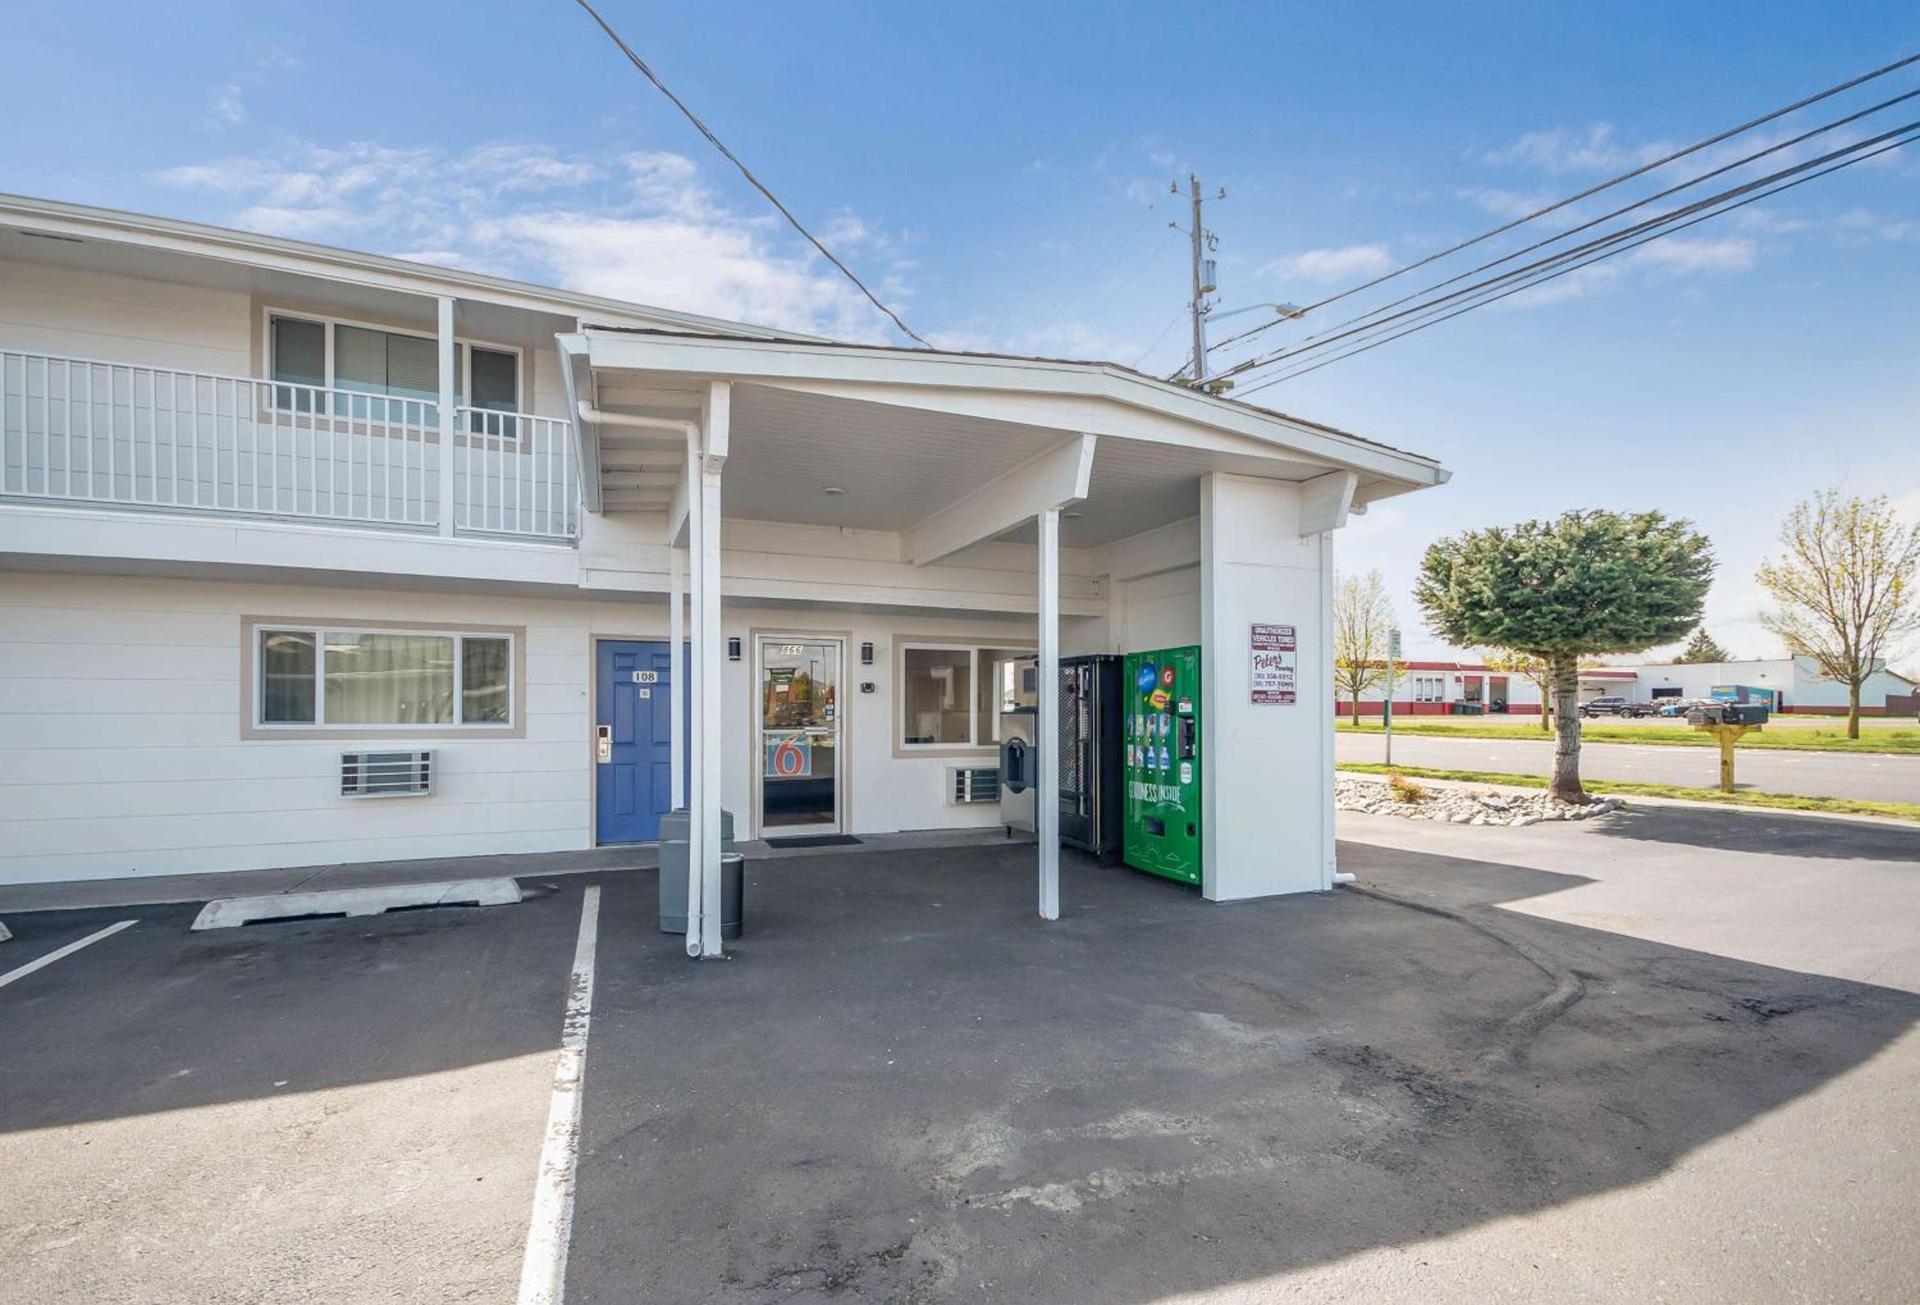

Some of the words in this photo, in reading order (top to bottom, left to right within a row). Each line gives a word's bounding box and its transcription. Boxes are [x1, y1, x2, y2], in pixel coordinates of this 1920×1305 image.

[636, 672, 655, 681] 108
[774, 735, 804, 777] 6
[1158, 784, 1181, 803] INSIDE
